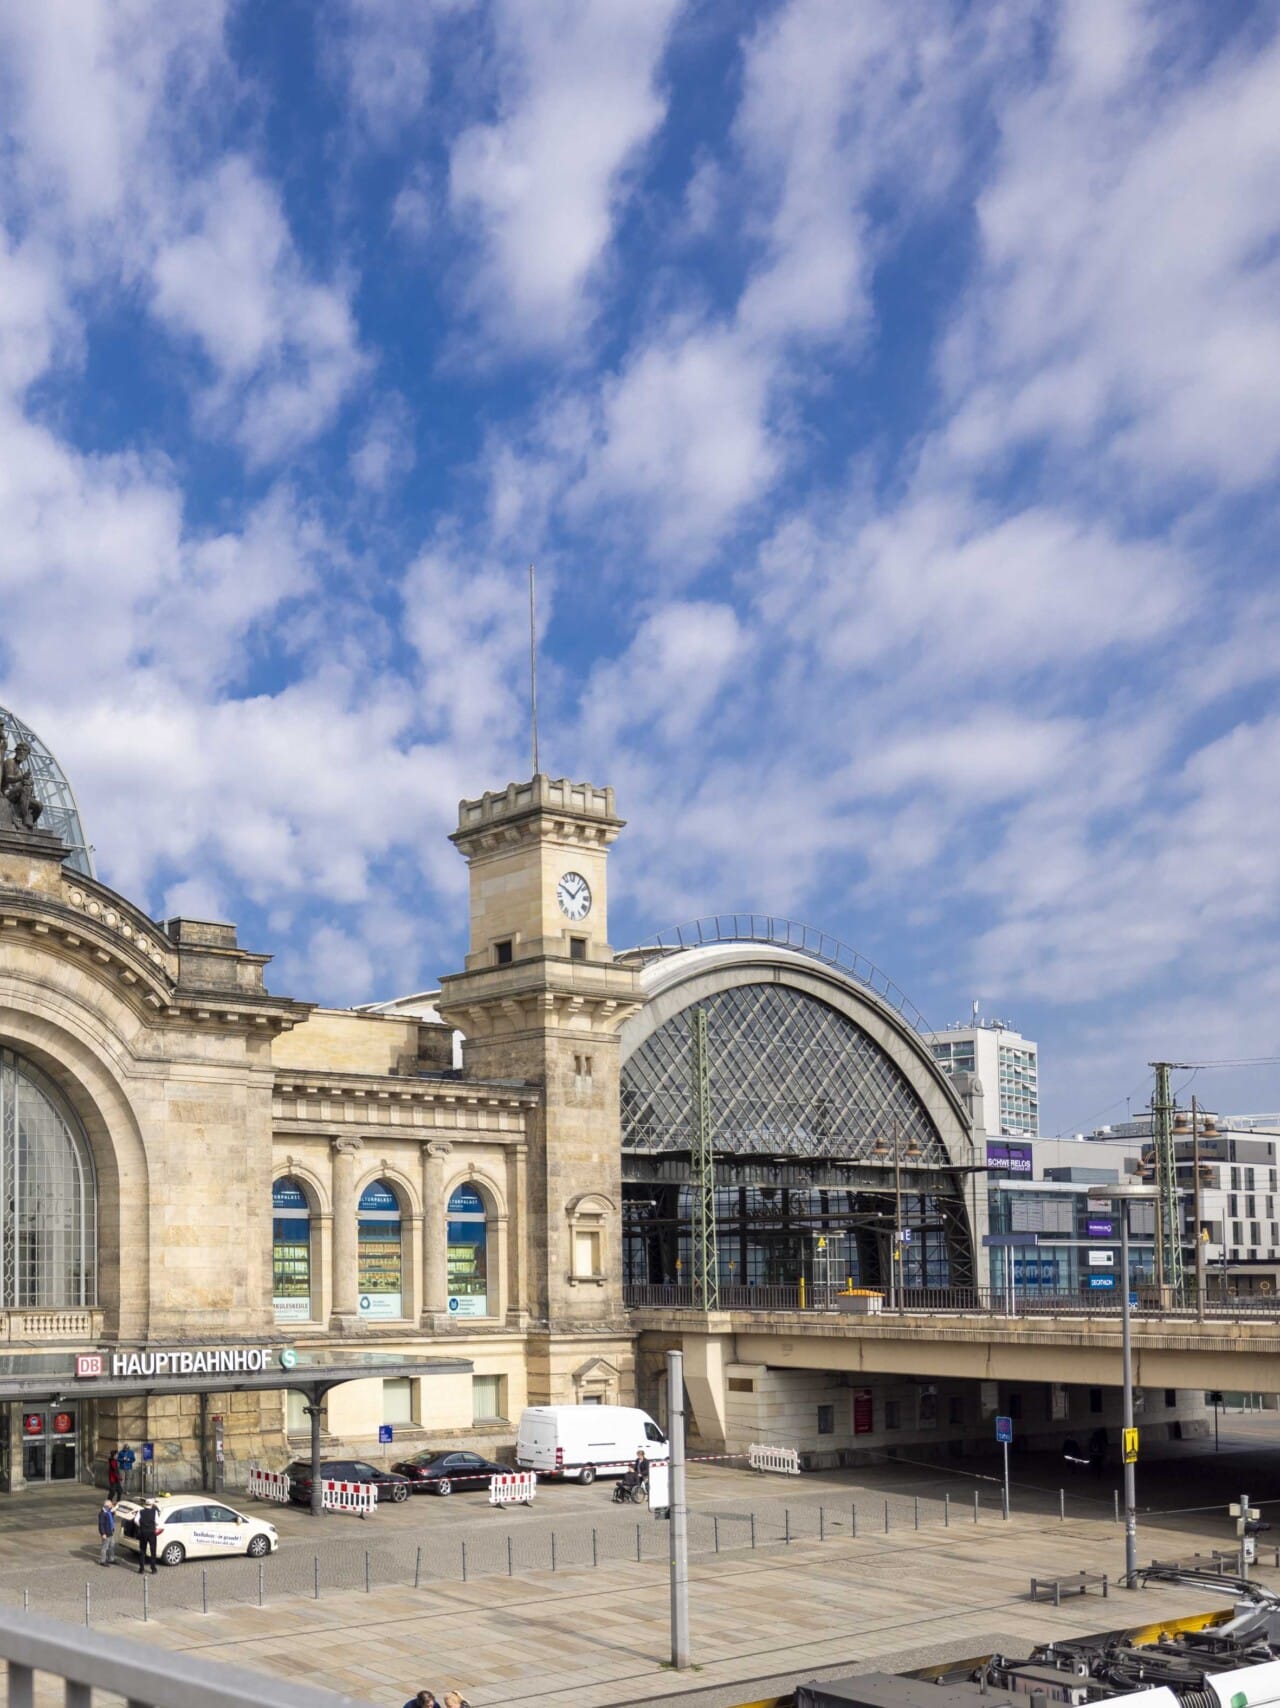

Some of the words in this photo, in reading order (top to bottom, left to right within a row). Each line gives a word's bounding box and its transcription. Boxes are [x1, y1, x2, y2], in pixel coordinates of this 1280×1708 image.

[80, 1356, 100, 1374] DB
[113, 1349, 272, 1376] HAUPTBAHNHOF
[282, 1350, 297, 1367] S
